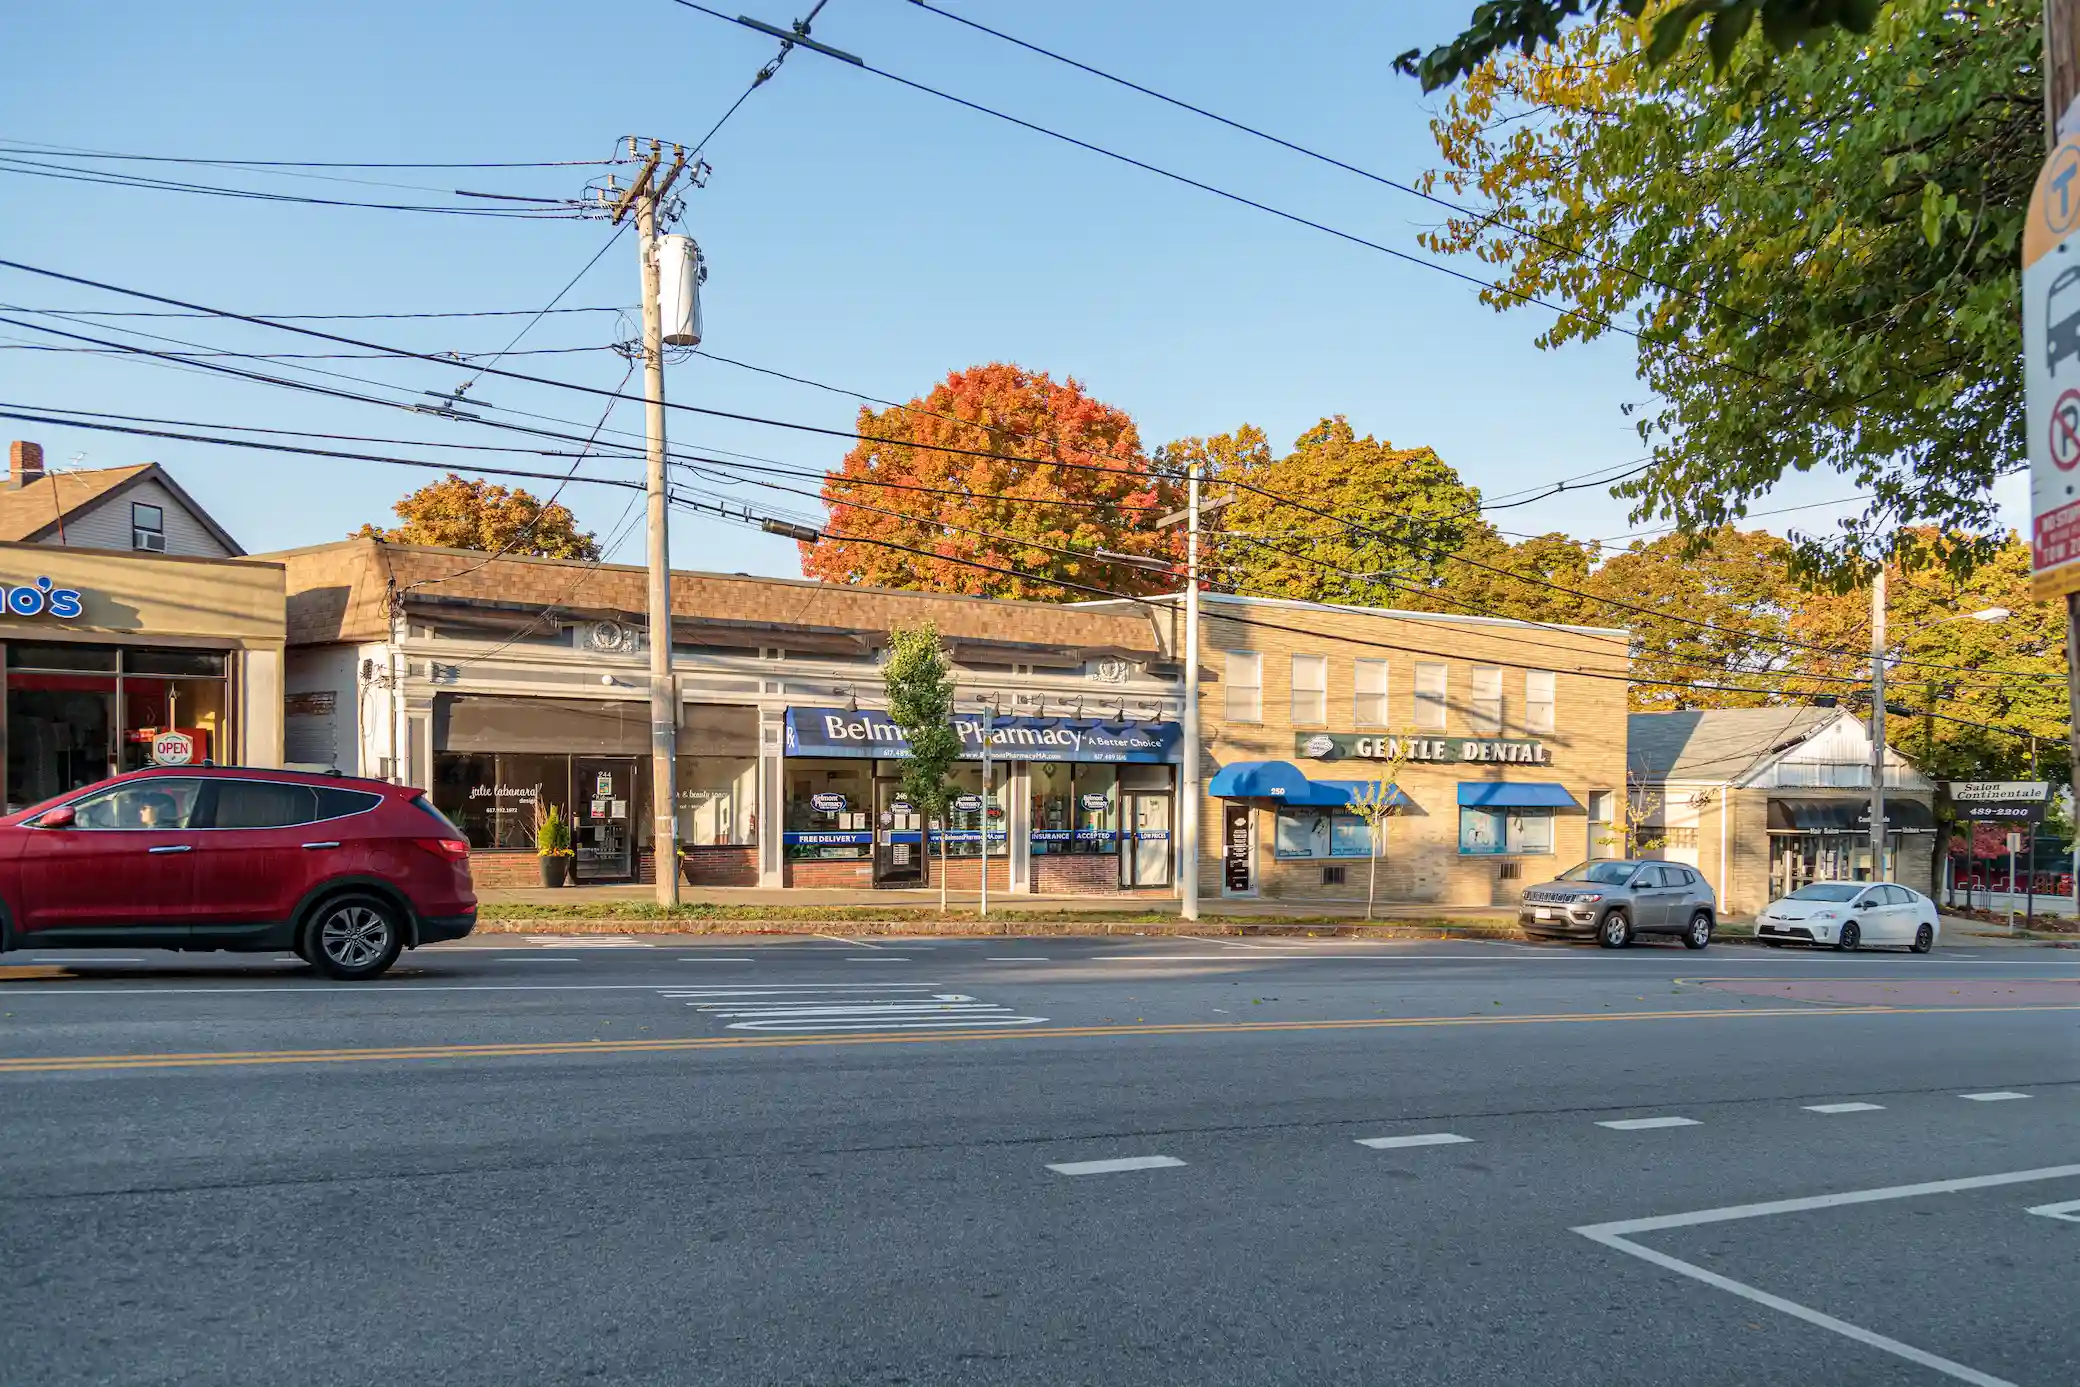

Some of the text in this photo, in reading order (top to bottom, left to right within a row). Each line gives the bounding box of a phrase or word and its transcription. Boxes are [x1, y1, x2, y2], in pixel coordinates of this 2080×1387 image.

[0, 575, 83, 618] o's
[825, 715, 908, 741] Belm
[954, 720, 1081, 751] Pharmacy
[1097, 737, 1128, 746] Better
[157, 742, 188, 754] OPEN
[1357, 737, 1546, 762] GENTLE DENTAL
[955, 750, 1061, 760] www.BmontPharmacyMA.com
[1270, 787, 1285, 795] 250
[1964, 784, 2000, 792] Salon
[1957, 789, 2042, 800] Continentale
[815, 800, 843, 809] Pharmacy
